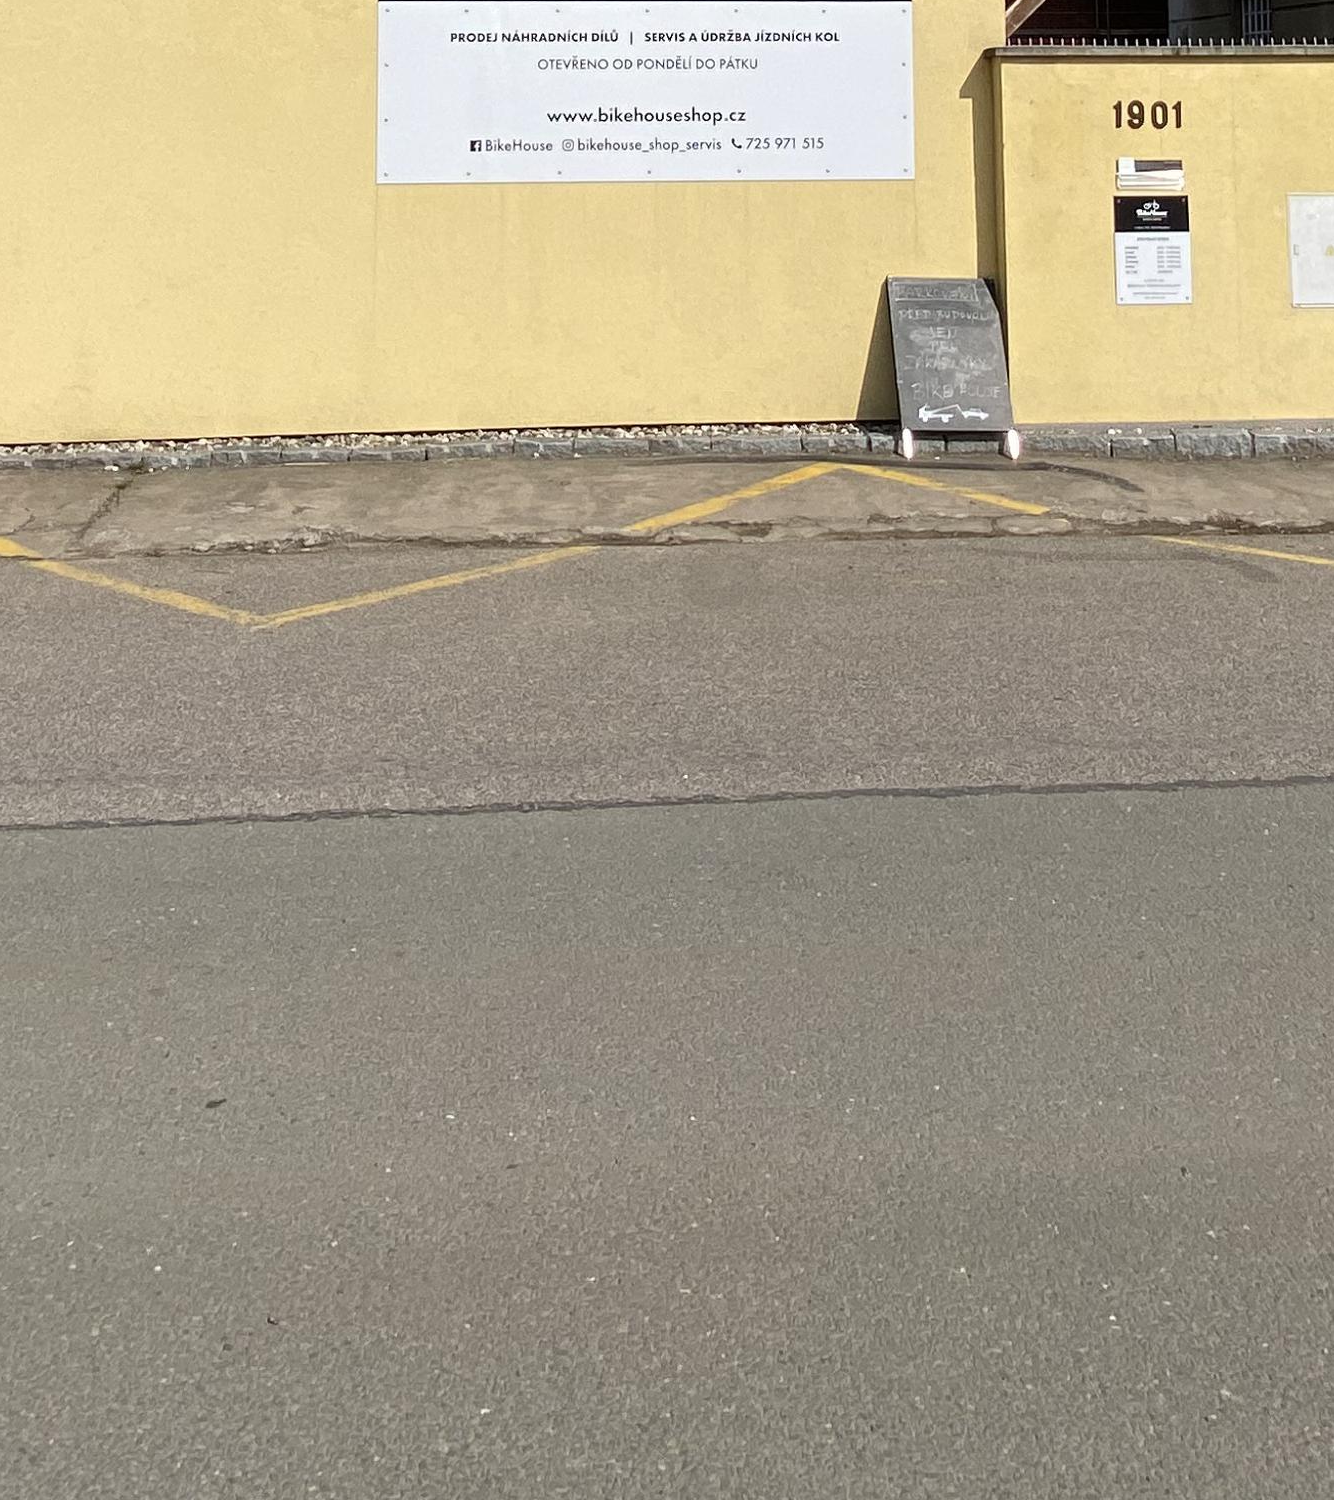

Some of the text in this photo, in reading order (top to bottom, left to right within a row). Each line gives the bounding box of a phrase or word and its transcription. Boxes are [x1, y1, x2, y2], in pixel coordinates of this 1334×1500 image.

[450, 29, 841, 43] PRODEJ NÁHRADNÍCH DÍLŮ SERVIS A ÚDRŽBA JÍZDNÍCH KOL
[537, 55, 758, 70] OTEVŘENO OD PONDĚLÍ DO PÁTKU
[547, 106, 747, 126] www.bikehouseshop.cz
[1113, 100, 1182, 130] 1901
[485, 137, 825, 154] BikeHouse bikehouse_shop_servis 725 971 515
